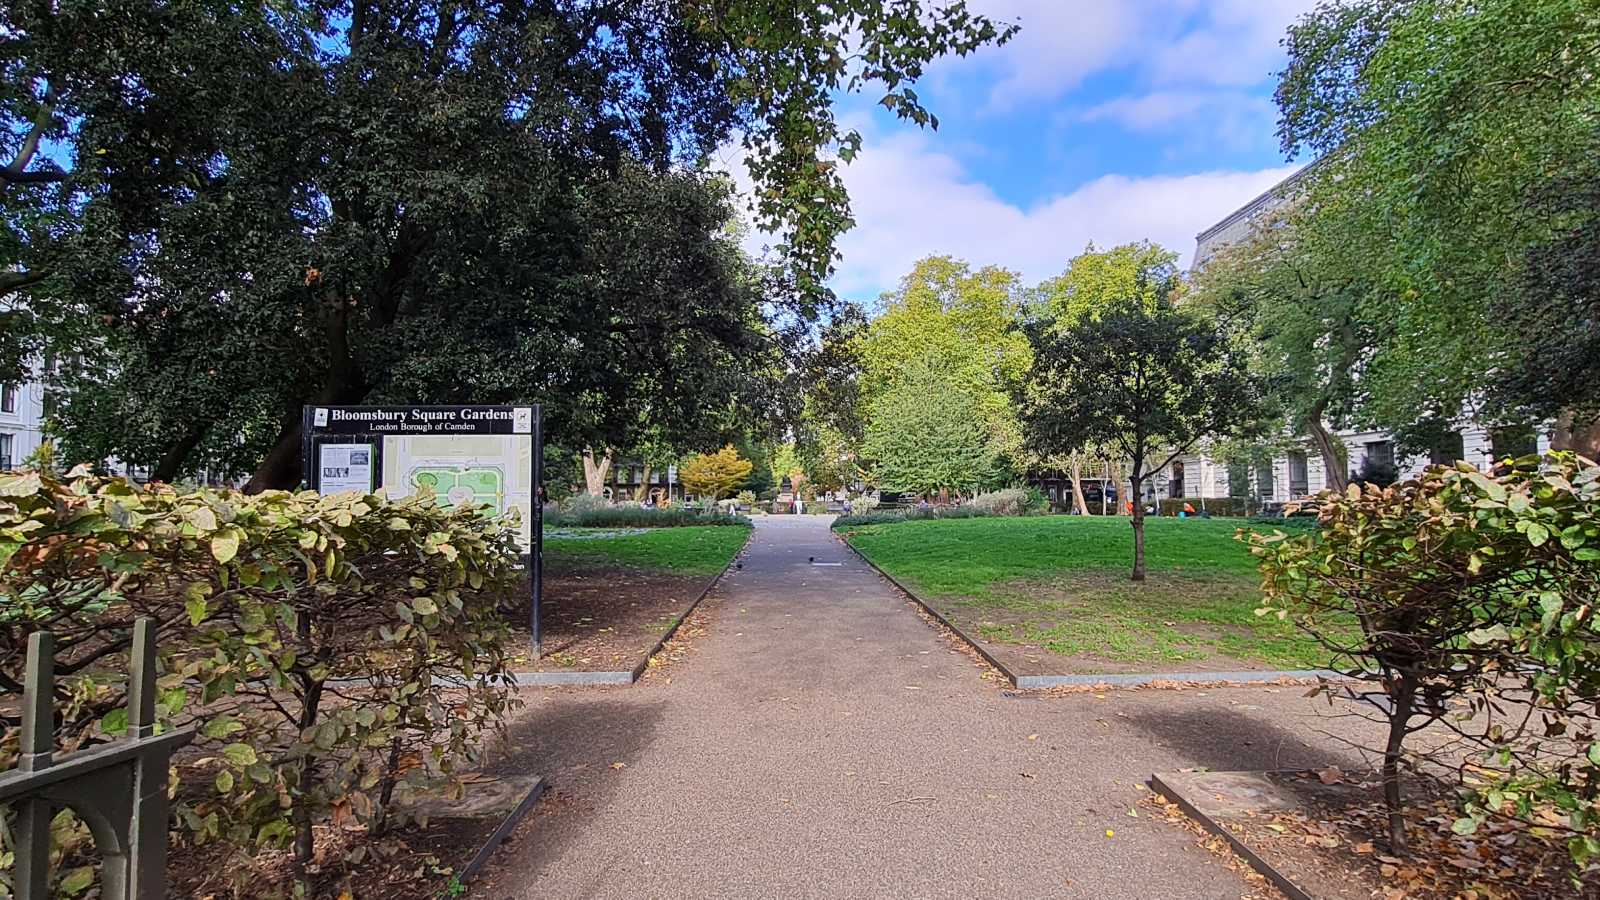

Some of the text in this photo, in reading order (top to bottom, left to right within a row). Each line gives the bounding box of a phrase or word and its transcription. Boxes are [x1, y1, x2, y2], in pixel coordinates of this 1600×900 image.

[332, 409, 514, 422] Bloomsbury Square Gardens
[369, 422, 475, 432] London Borough of Camden
